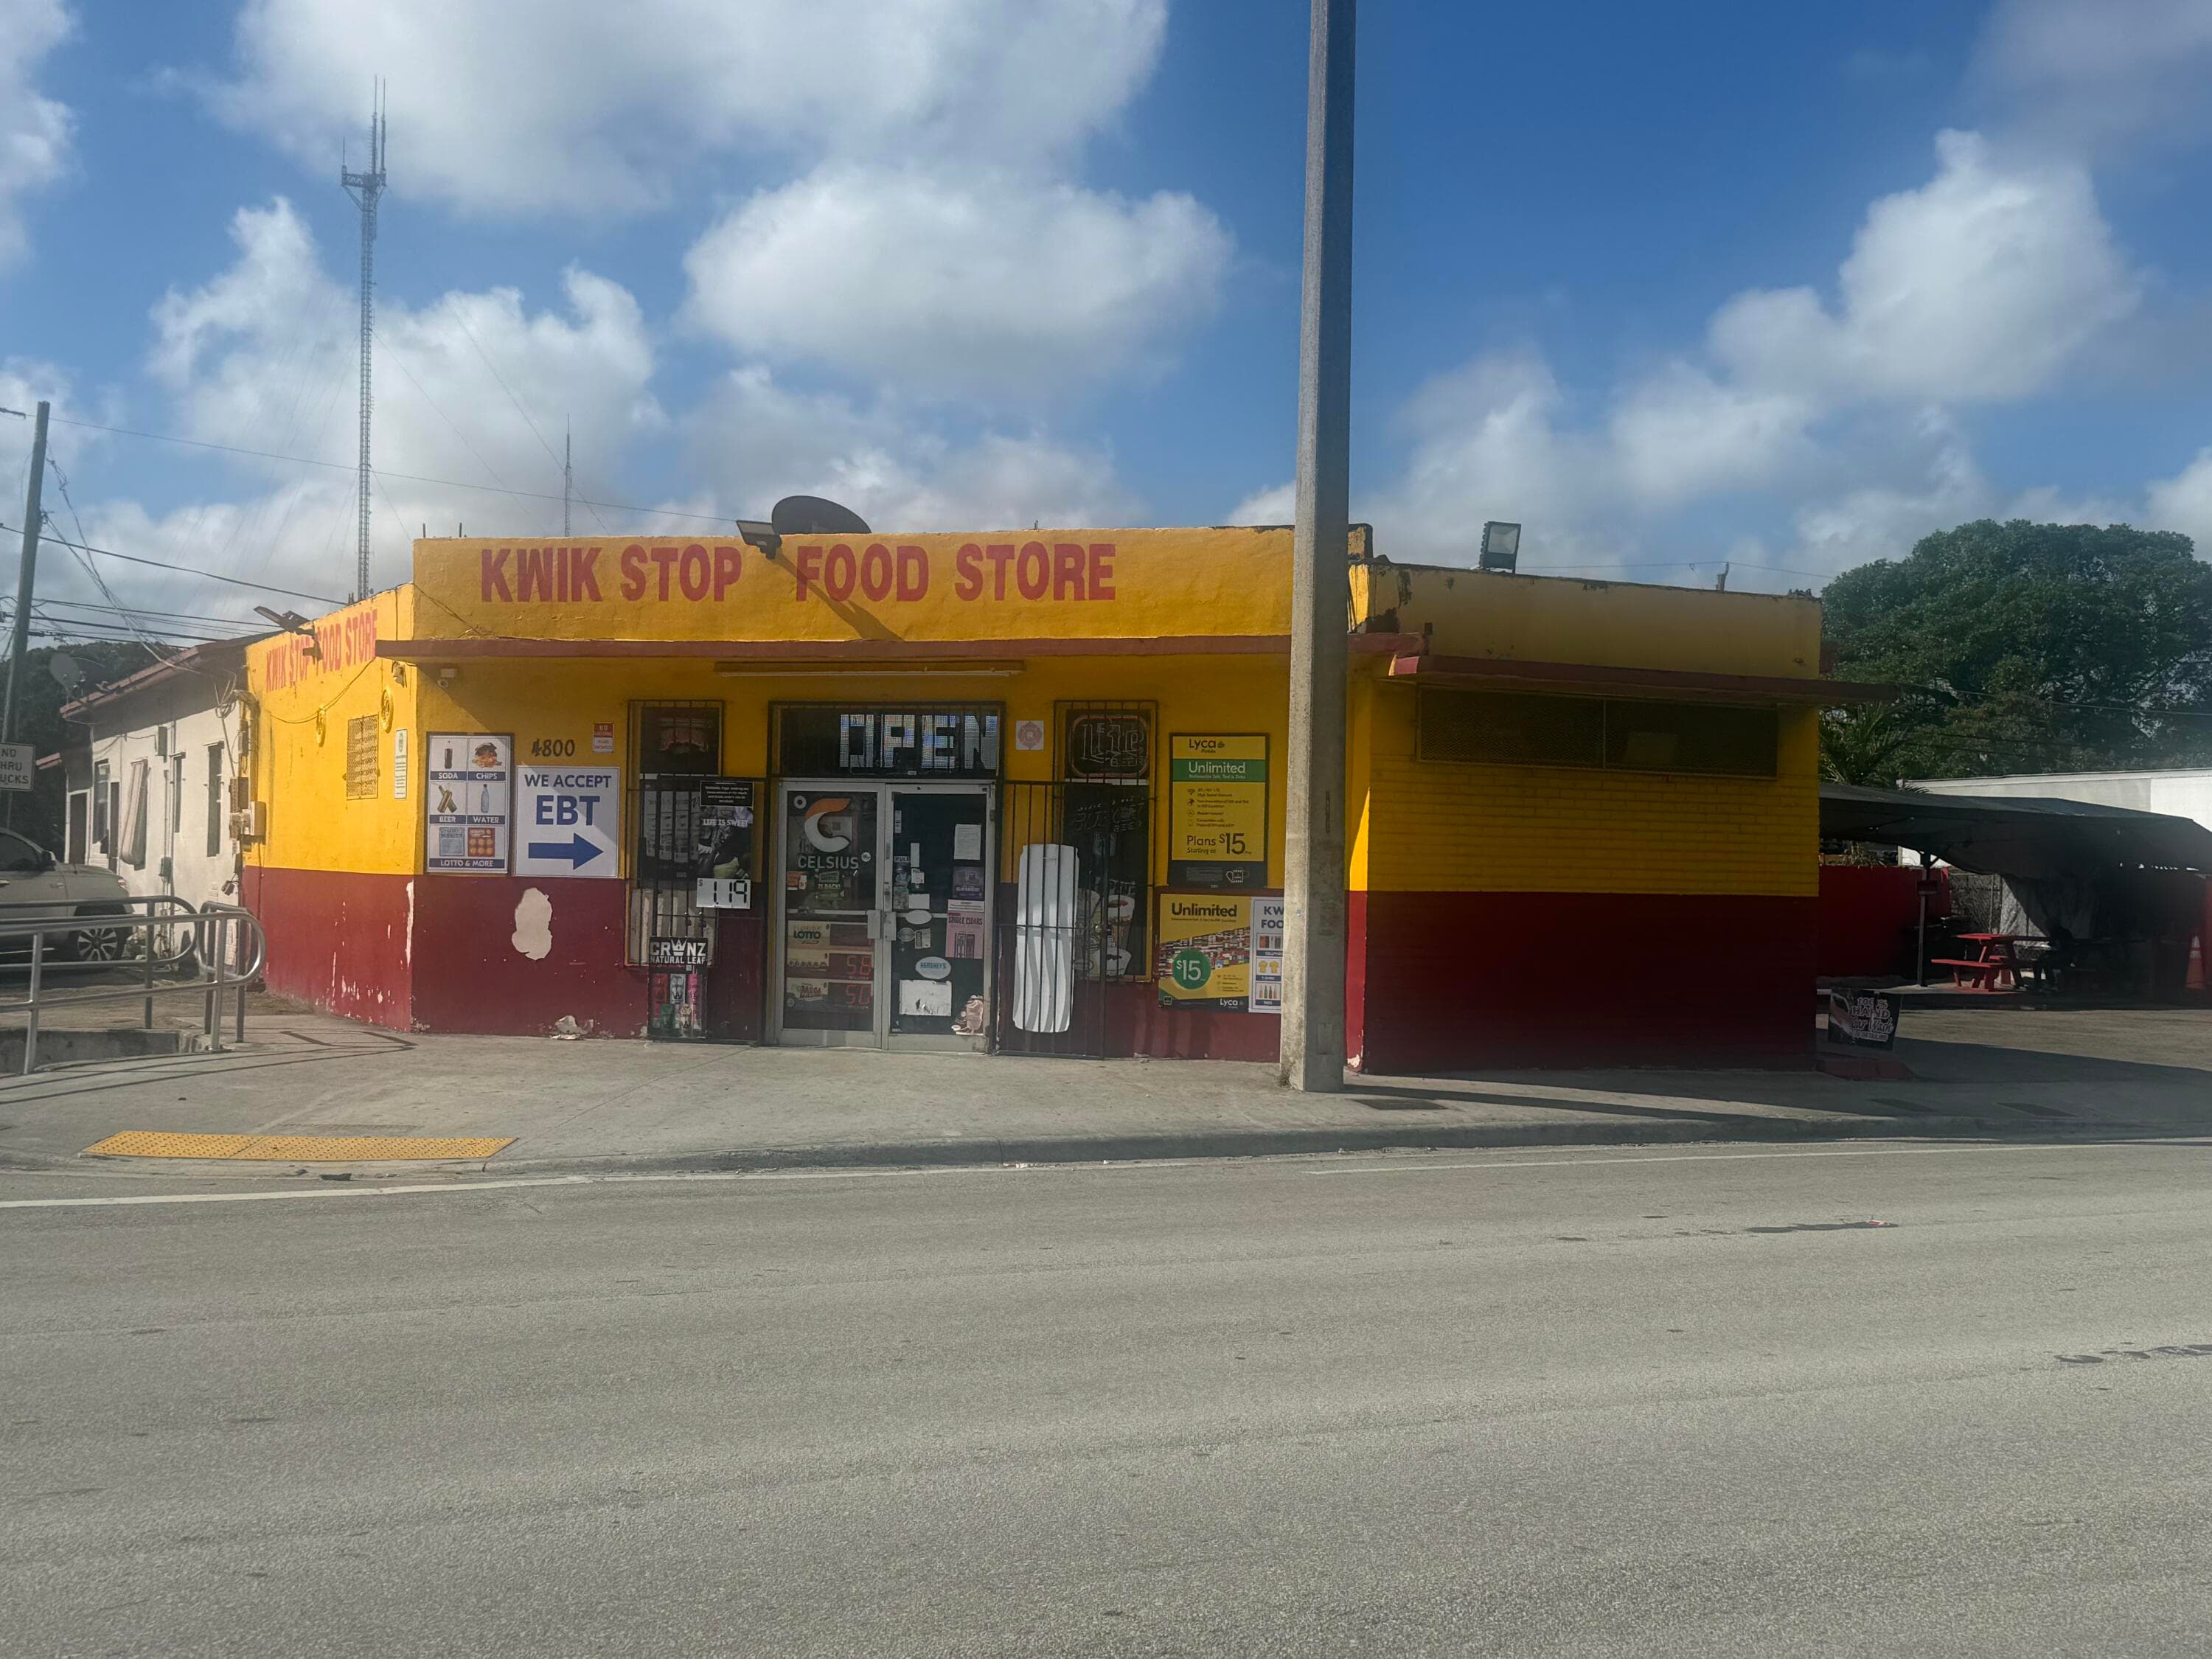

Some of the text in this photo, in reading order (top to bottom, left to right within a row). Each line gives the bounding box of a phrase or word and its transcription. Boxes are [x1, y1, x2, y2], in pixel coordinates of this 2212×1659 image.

[481, 541, 1116, 602] KWIK STOP FOOD STORE
[266, 644, 287, 694] KWIK
[345, 609, 378, 667] STORE
[531, 738, 576, 757] 4800
[840, 714, 998, 769] OPEN
[1189, 738, 1216, 750] Lyca
[1, 748, 16, 757] NO
[1189, 762, 1245, 773] Unlimited
[524, 774, 612, 788] WE ACCEPT
[536, 795, 600, 826] EBT
[1186, 832, 1246, 855] Plans $15
[798, 855, 859, 869] CELSIUS
[1171, 902, 1237, 917] Unlimited
[793, 931, 821, 939] LOTTO
[650, 956, 684, 964] NATURAL
[1176, 959, 1202, 981] $15
[1220, 998, 1238, 1006] Lyca
[1851, 1005, 1891, 1020] HAND
